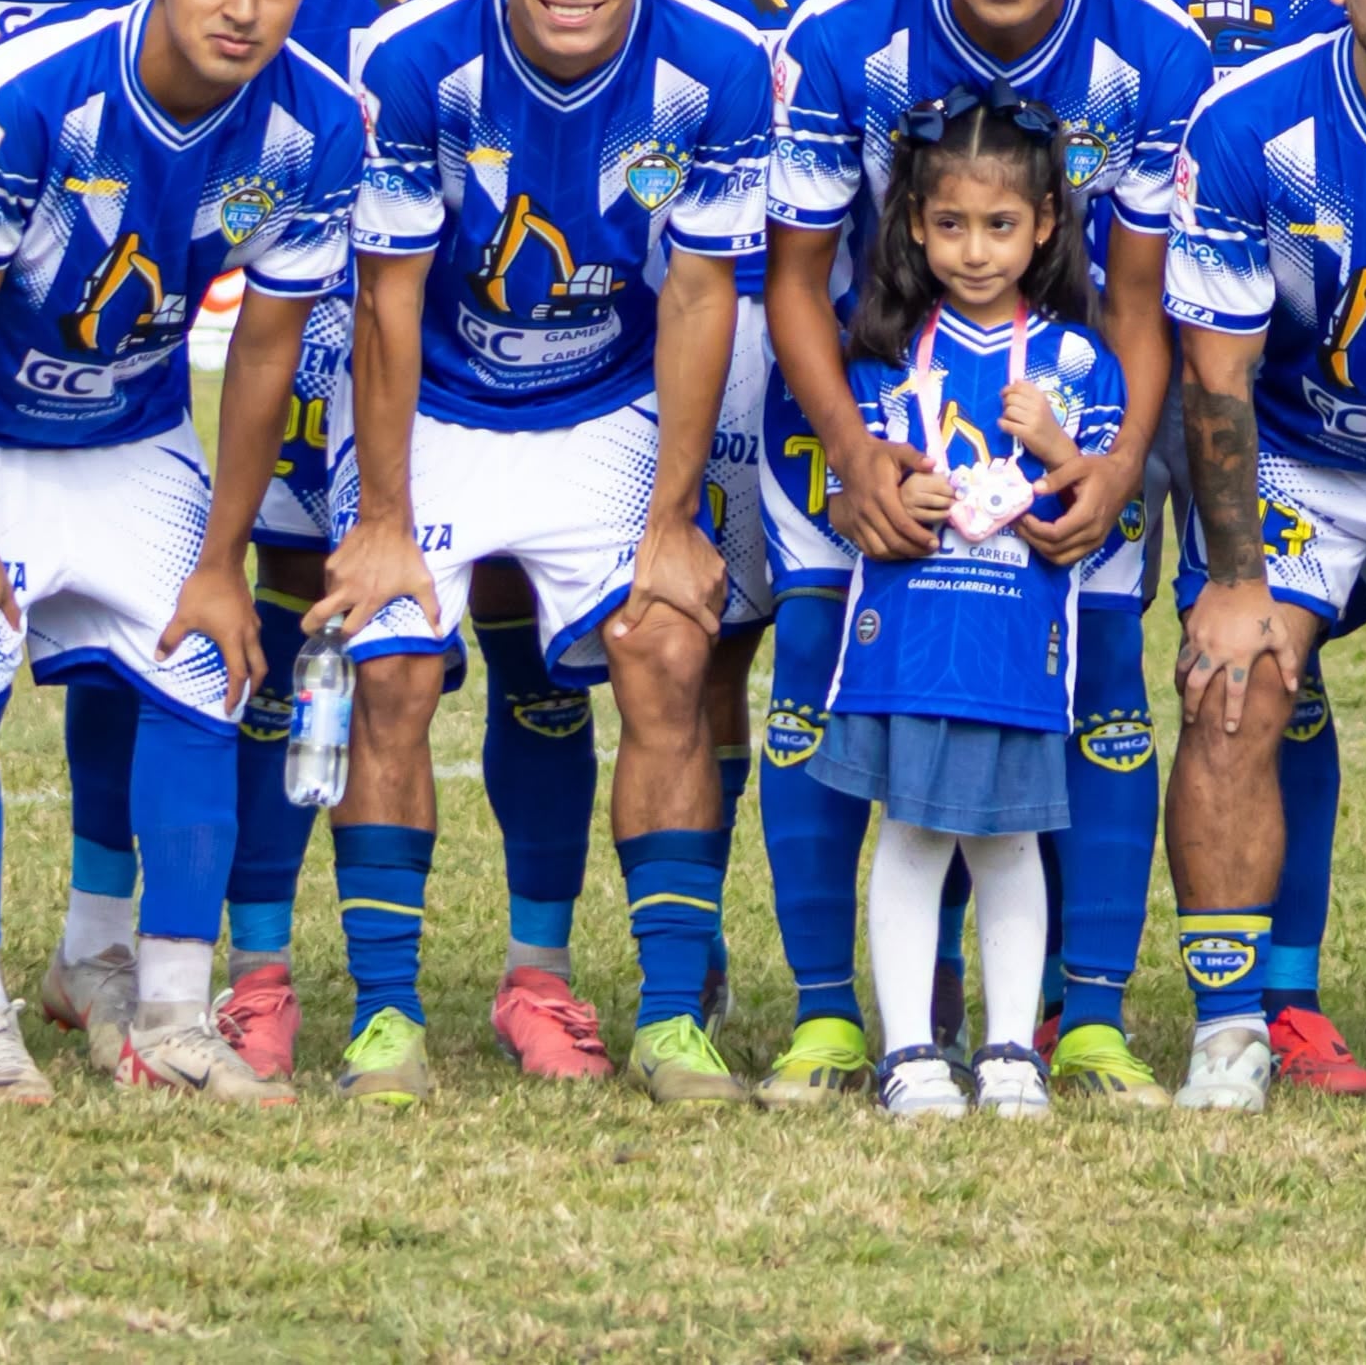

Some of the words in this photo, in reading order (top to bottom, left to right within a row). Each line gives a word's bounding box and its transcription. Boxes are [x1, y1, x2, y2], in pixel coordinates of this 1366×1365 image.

[26, 359, 104, 396] GC
[969, 546, 1023, 565] CARRERA
[908, 579, 952, 591] GAMBOA
[953, 580, 997, 595] CARRERA
[1206, 955, 1246, 967] INCA
